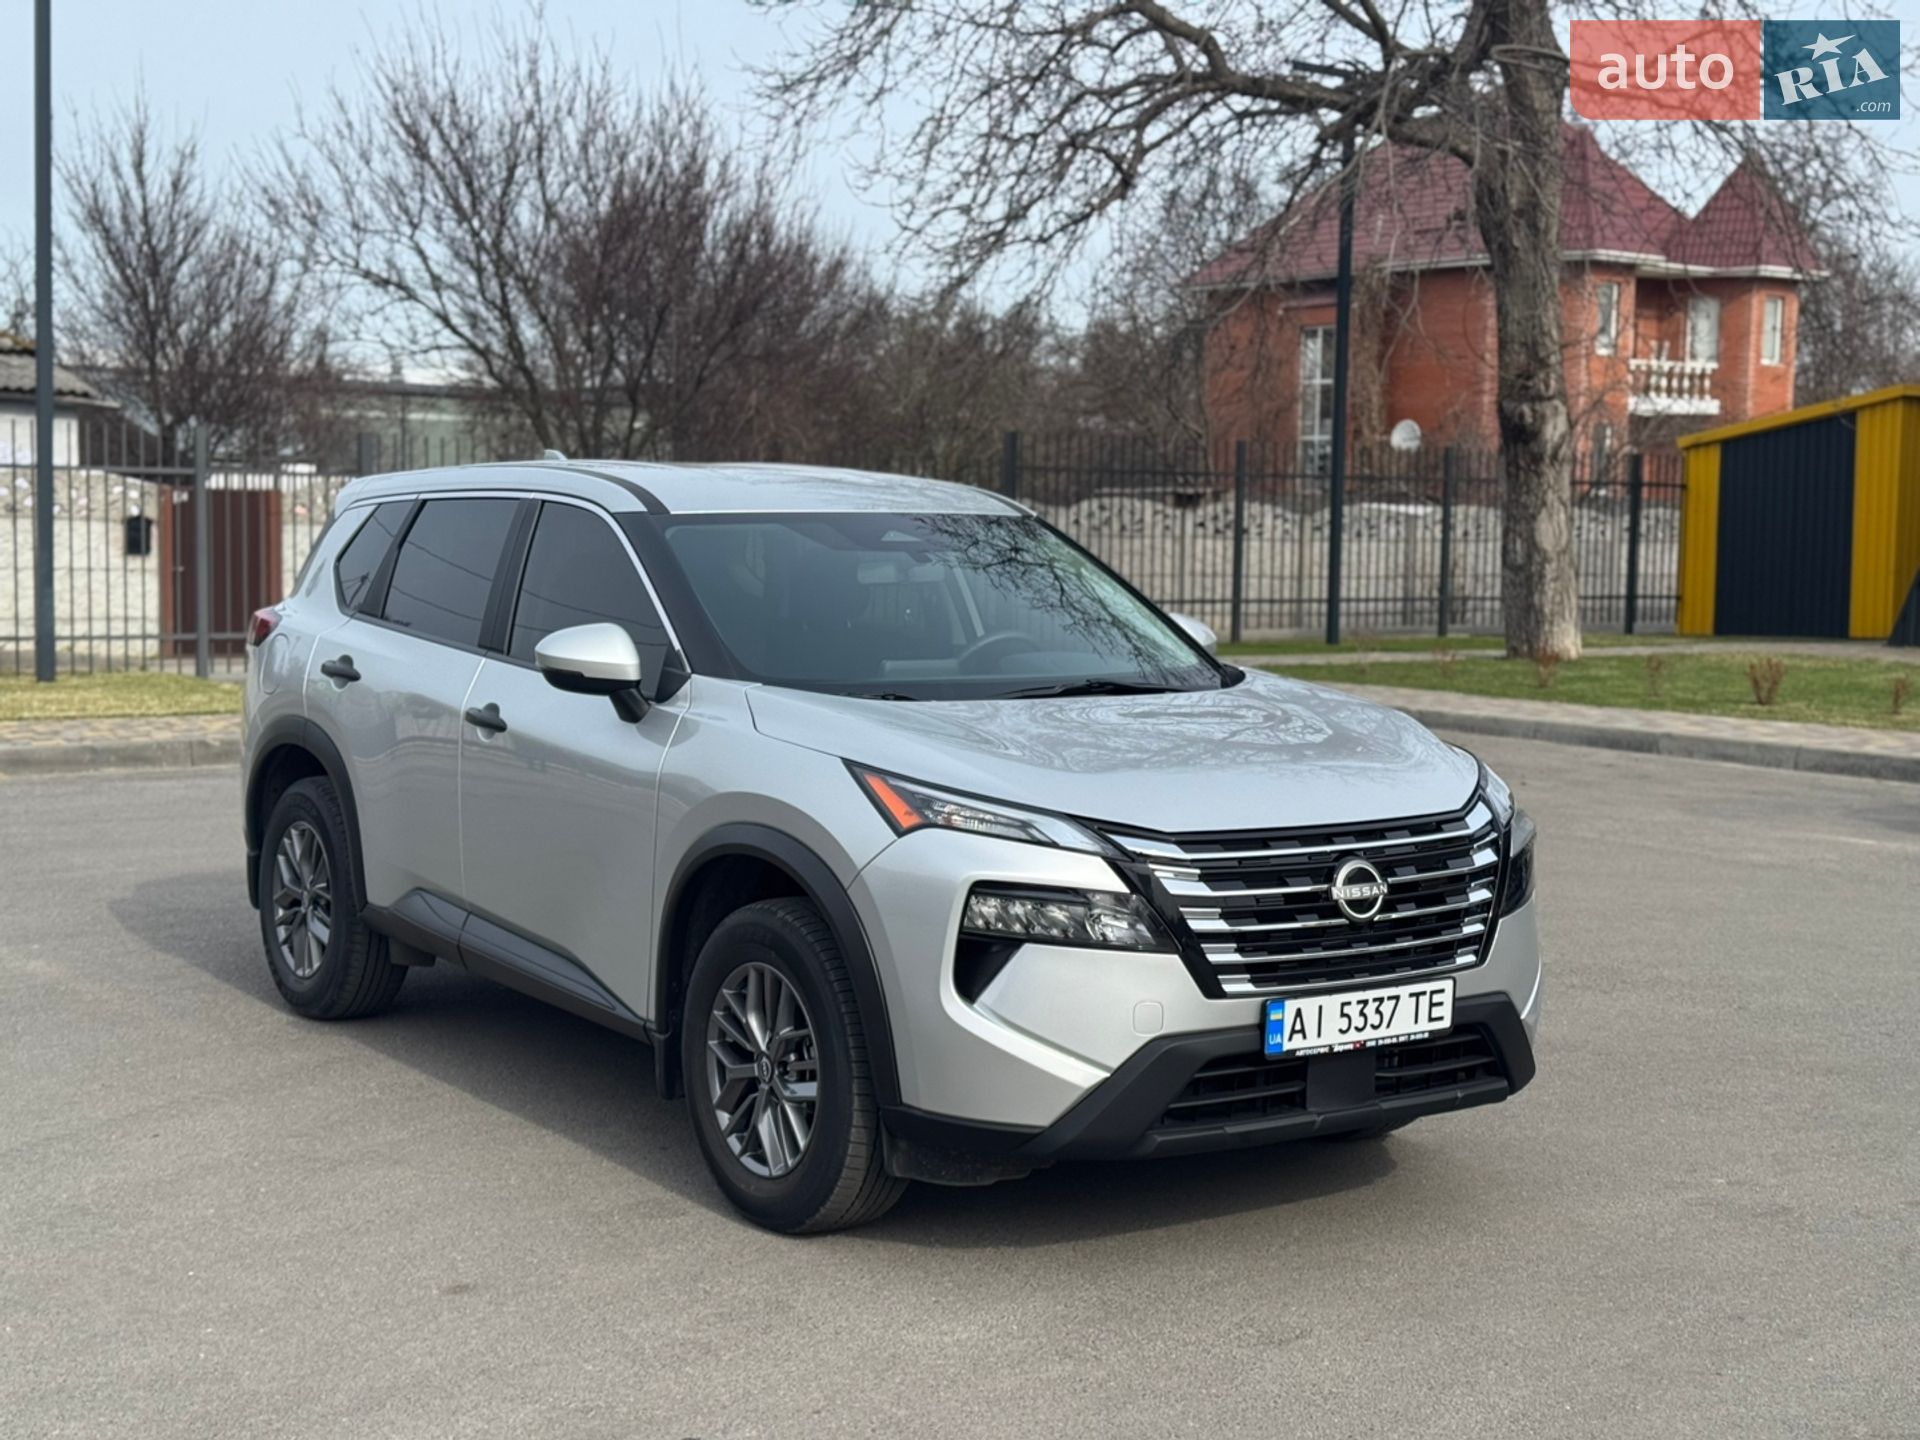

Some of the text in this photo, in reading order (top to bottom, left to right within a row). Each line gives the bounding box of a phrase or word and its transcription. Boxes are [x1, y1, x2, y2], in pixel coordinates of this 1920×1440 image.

[1332, 882, 1388, 900] NISSAN
[1288, 988, 1445, 1042] AI 5337 TE
[1269, 1034, 1281, 1045] UA
